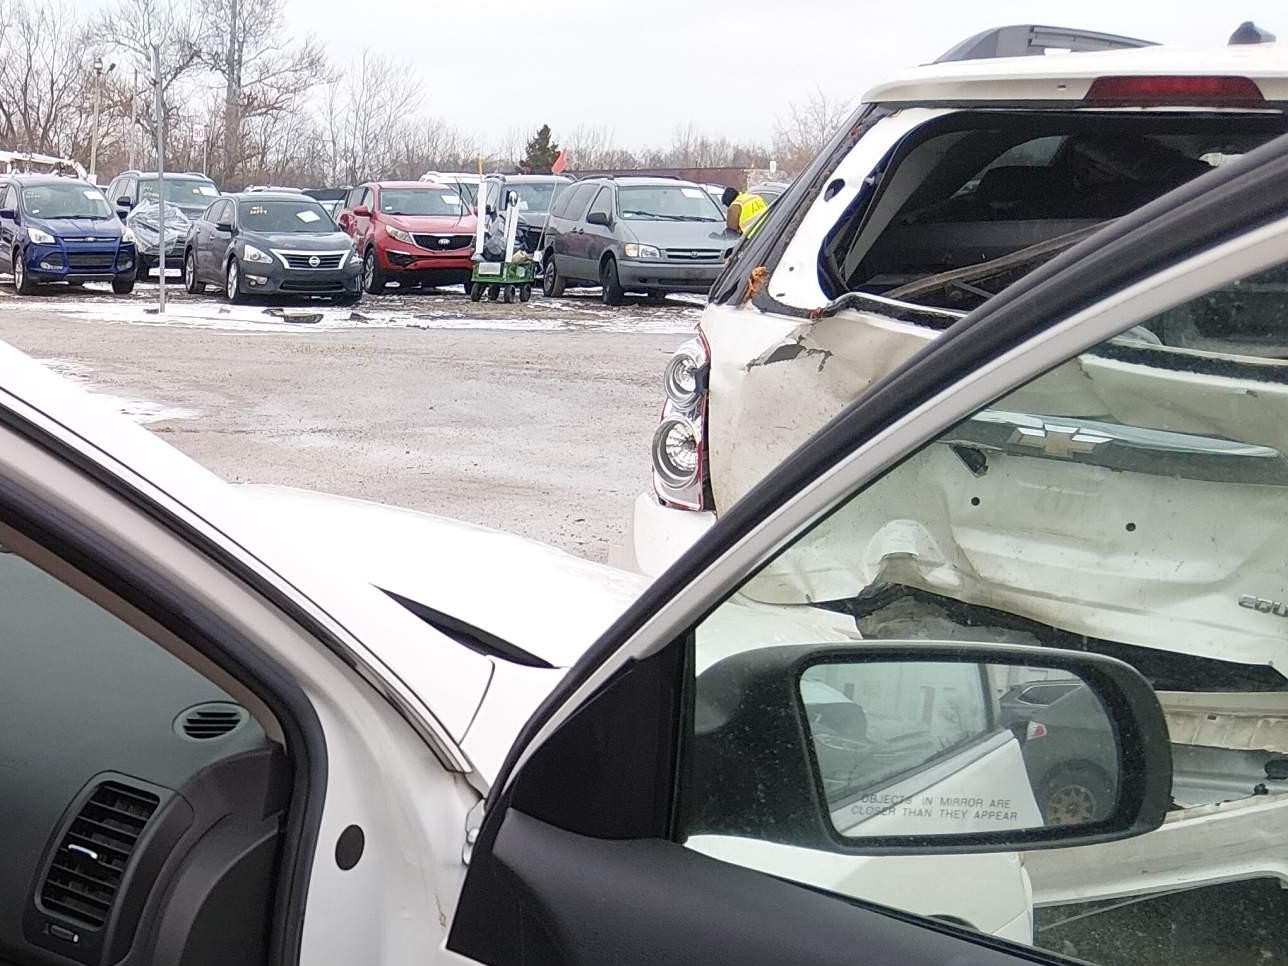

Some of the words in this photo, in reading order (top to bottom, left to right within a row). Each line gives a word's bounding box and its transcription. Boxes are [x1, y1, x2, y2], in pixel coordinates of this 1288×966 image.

[861, 794, 913, 805] OBJECTS
[921, 795, 933, 806] IN
[939, 796, 983, 809] MIRROR
[989, 798, 1012, 809] ARE
[850, 805, 896, 816] CLOSER
[902, 807, 932, 818] THAN
[939, 808, 968, 819] THEY
[973, 810, 1018, 821] APPEAR
